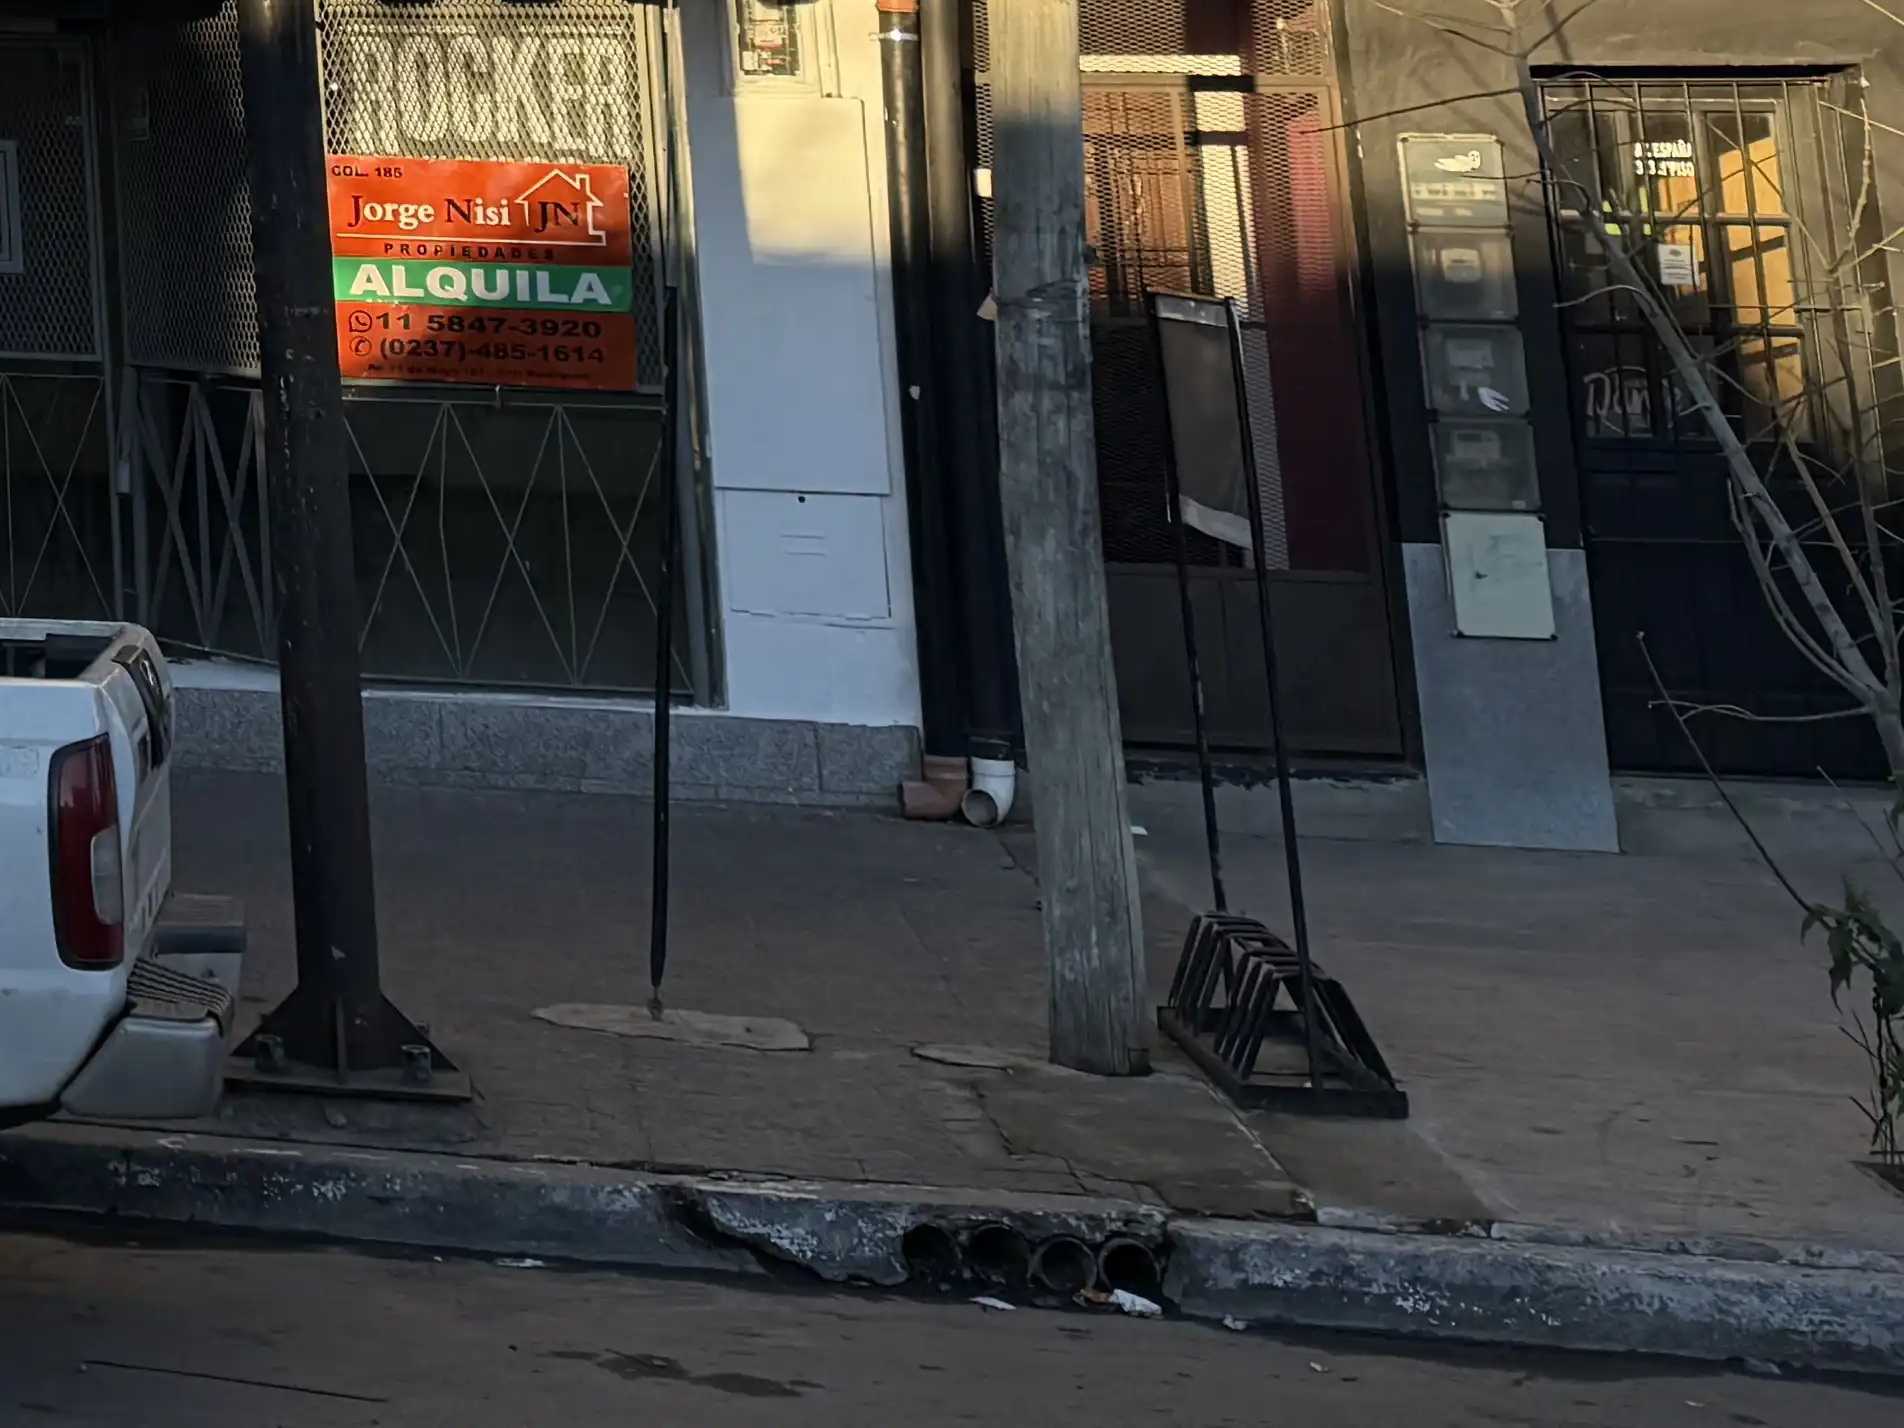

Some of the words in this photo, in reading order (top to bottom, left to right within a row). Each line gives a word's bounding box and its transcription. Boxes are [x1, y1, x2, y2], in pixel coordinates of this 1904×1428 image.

[347, 194, 435, 230] Jorge
[445, 197, 512, 227] Nisi
[534, 200, 581, 232] JN
[383, 243, 555, 261] PROPIEDADES
[349, 263, 613, 306] ALQUILA
[375, 312, 411, 331] 11
[427, 315, 602, 339] 5847-3920
